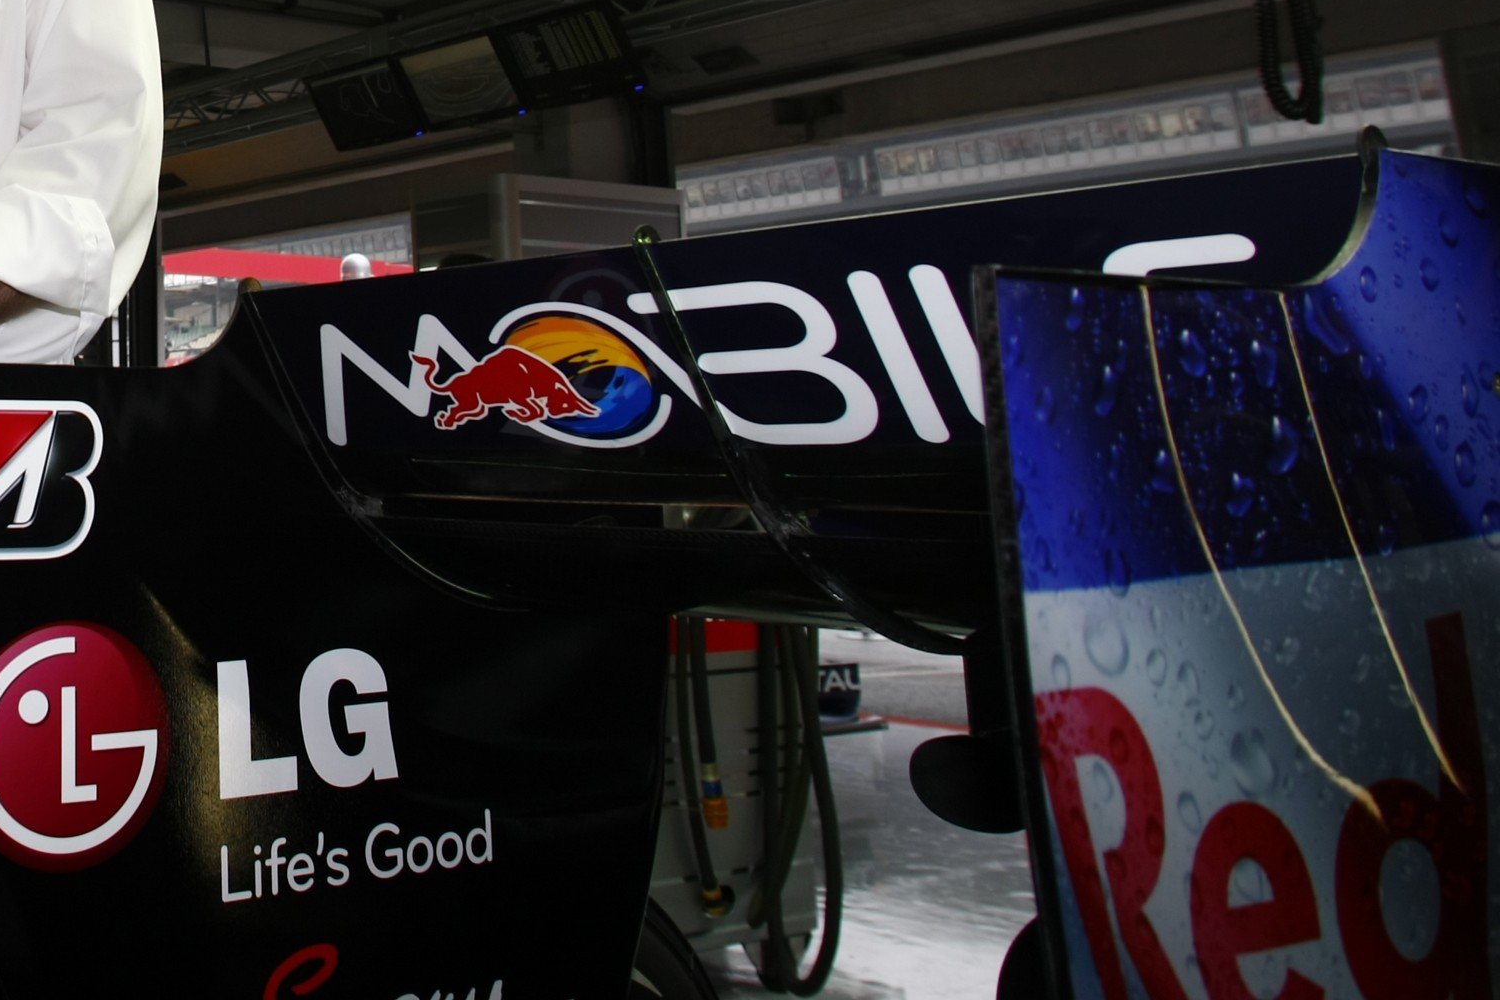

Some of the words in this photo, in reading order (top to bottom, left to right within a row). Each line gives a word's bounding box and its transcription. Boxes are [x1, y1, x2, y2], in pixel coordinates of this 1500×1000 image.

[216, 647, 399, 800] LG
[220, 832, 350, 902] Life's
[364, 808, 495, 879] Good
[1036, 611, 1490, 1000] Red
